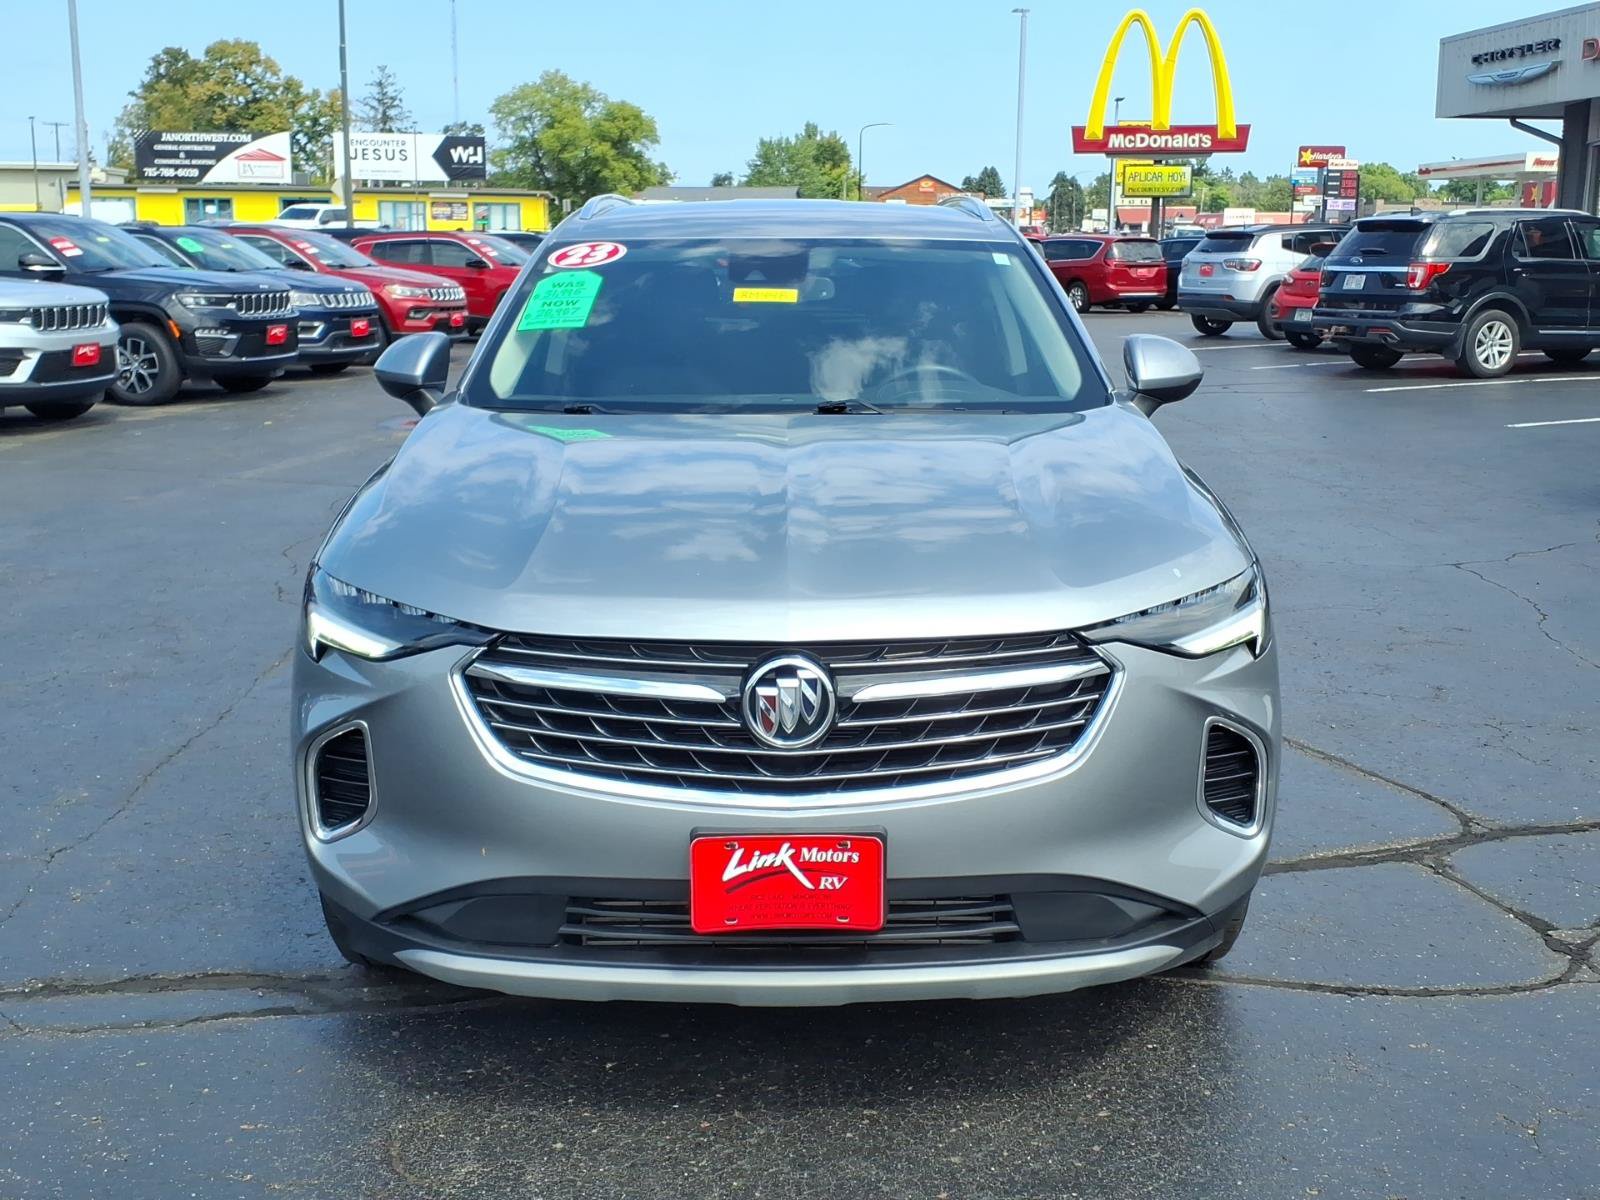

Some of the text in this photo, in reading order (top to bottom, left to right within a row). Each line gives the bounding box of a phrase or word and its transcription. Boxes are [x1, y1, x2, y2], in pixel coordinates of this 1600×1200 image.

[1471, 38, 1561, 65] CHRYSLER
[160, 132, 252, 143] JANORTHWEST.COM
[350, 139, 407, 147] ENCOUNTER
[1108, 133, 1212, 148] McDonald's
[350, 148, 408, 162] JESUS
[1128, 171, 1163, 182] APLICAR
[1167, 171, 1187, 182] HOY!
[552, 281, 586, 289] WAS
[542, 299, 580, 308] NOW
[722, 843, 860, 889] Link Motors
[818, 876, 848, 890] RV
